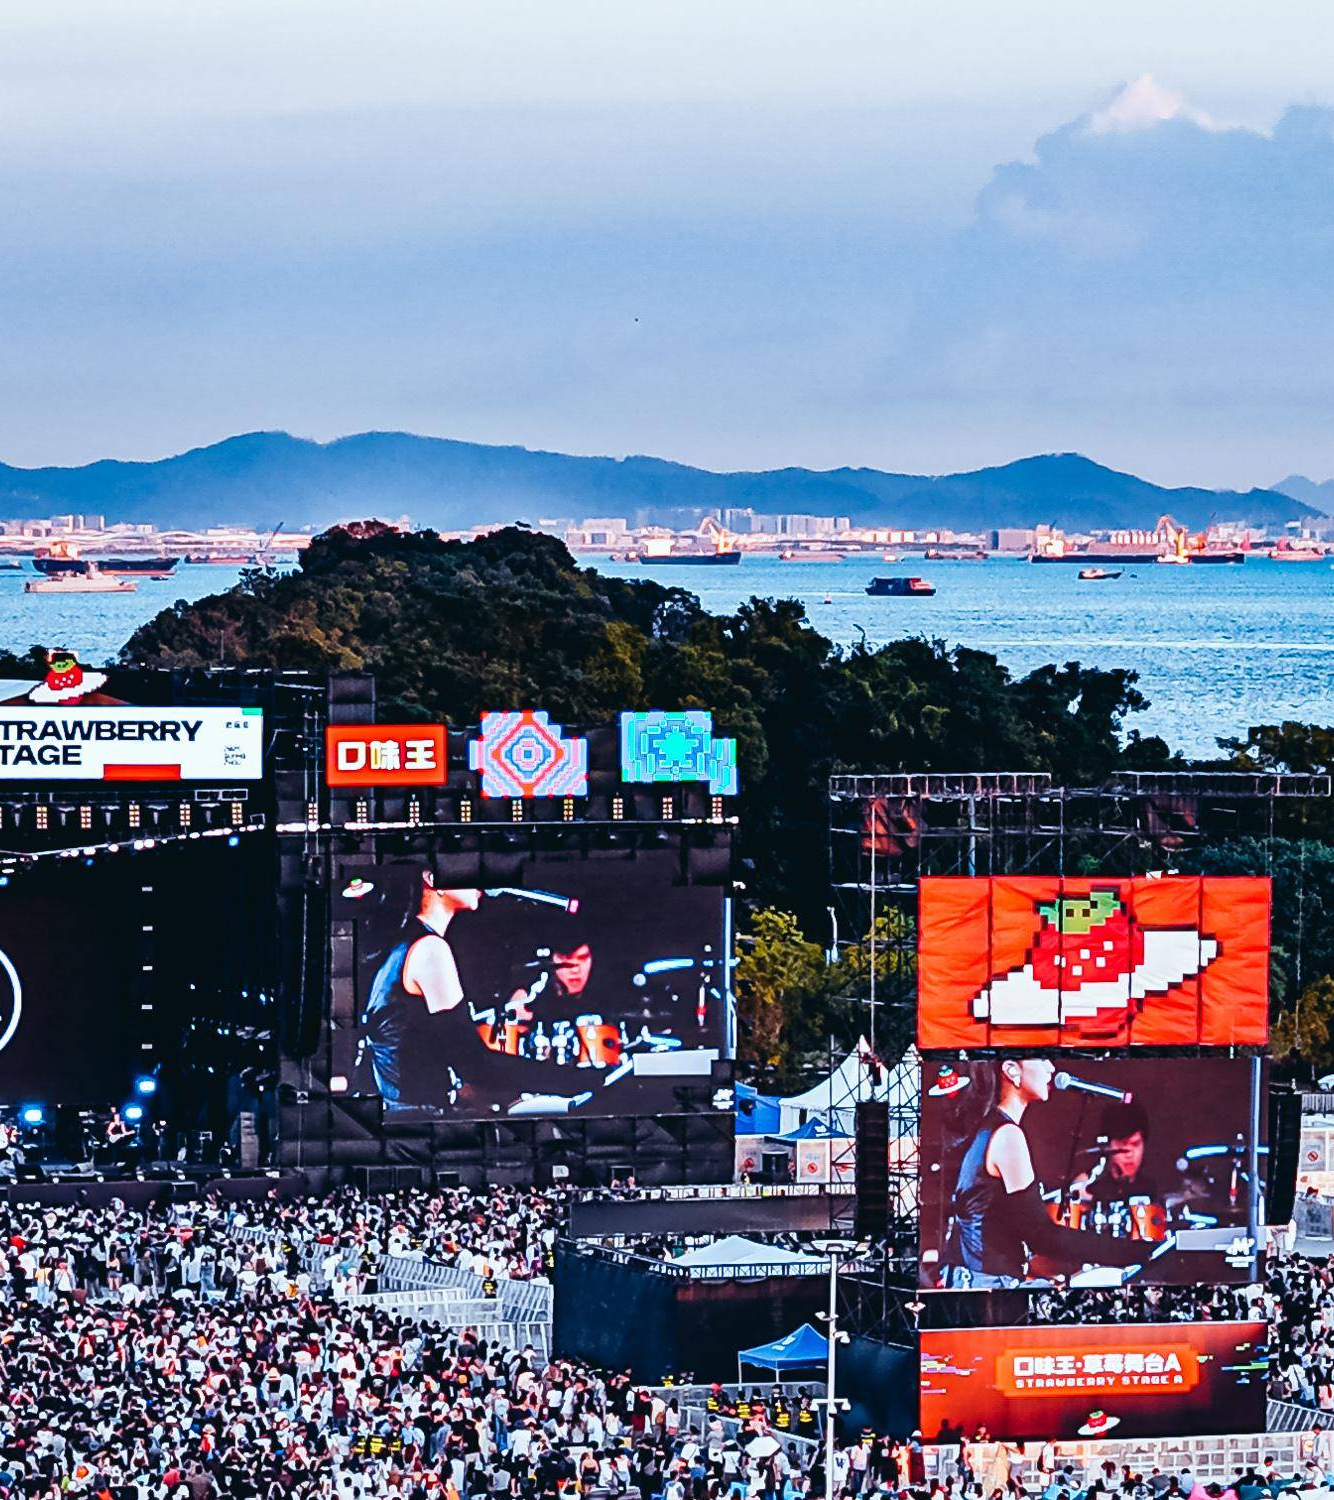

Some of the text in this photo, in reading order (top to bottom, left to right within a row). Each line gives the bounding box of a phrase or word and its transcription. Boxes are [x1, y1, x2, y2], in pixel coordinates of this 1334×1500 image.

[338, 739, 437, 771] 口味王
[1016, 1376, 1115, 1388] STRAWBERRY
[1121, 1375, 1169, 1385] STAGE
